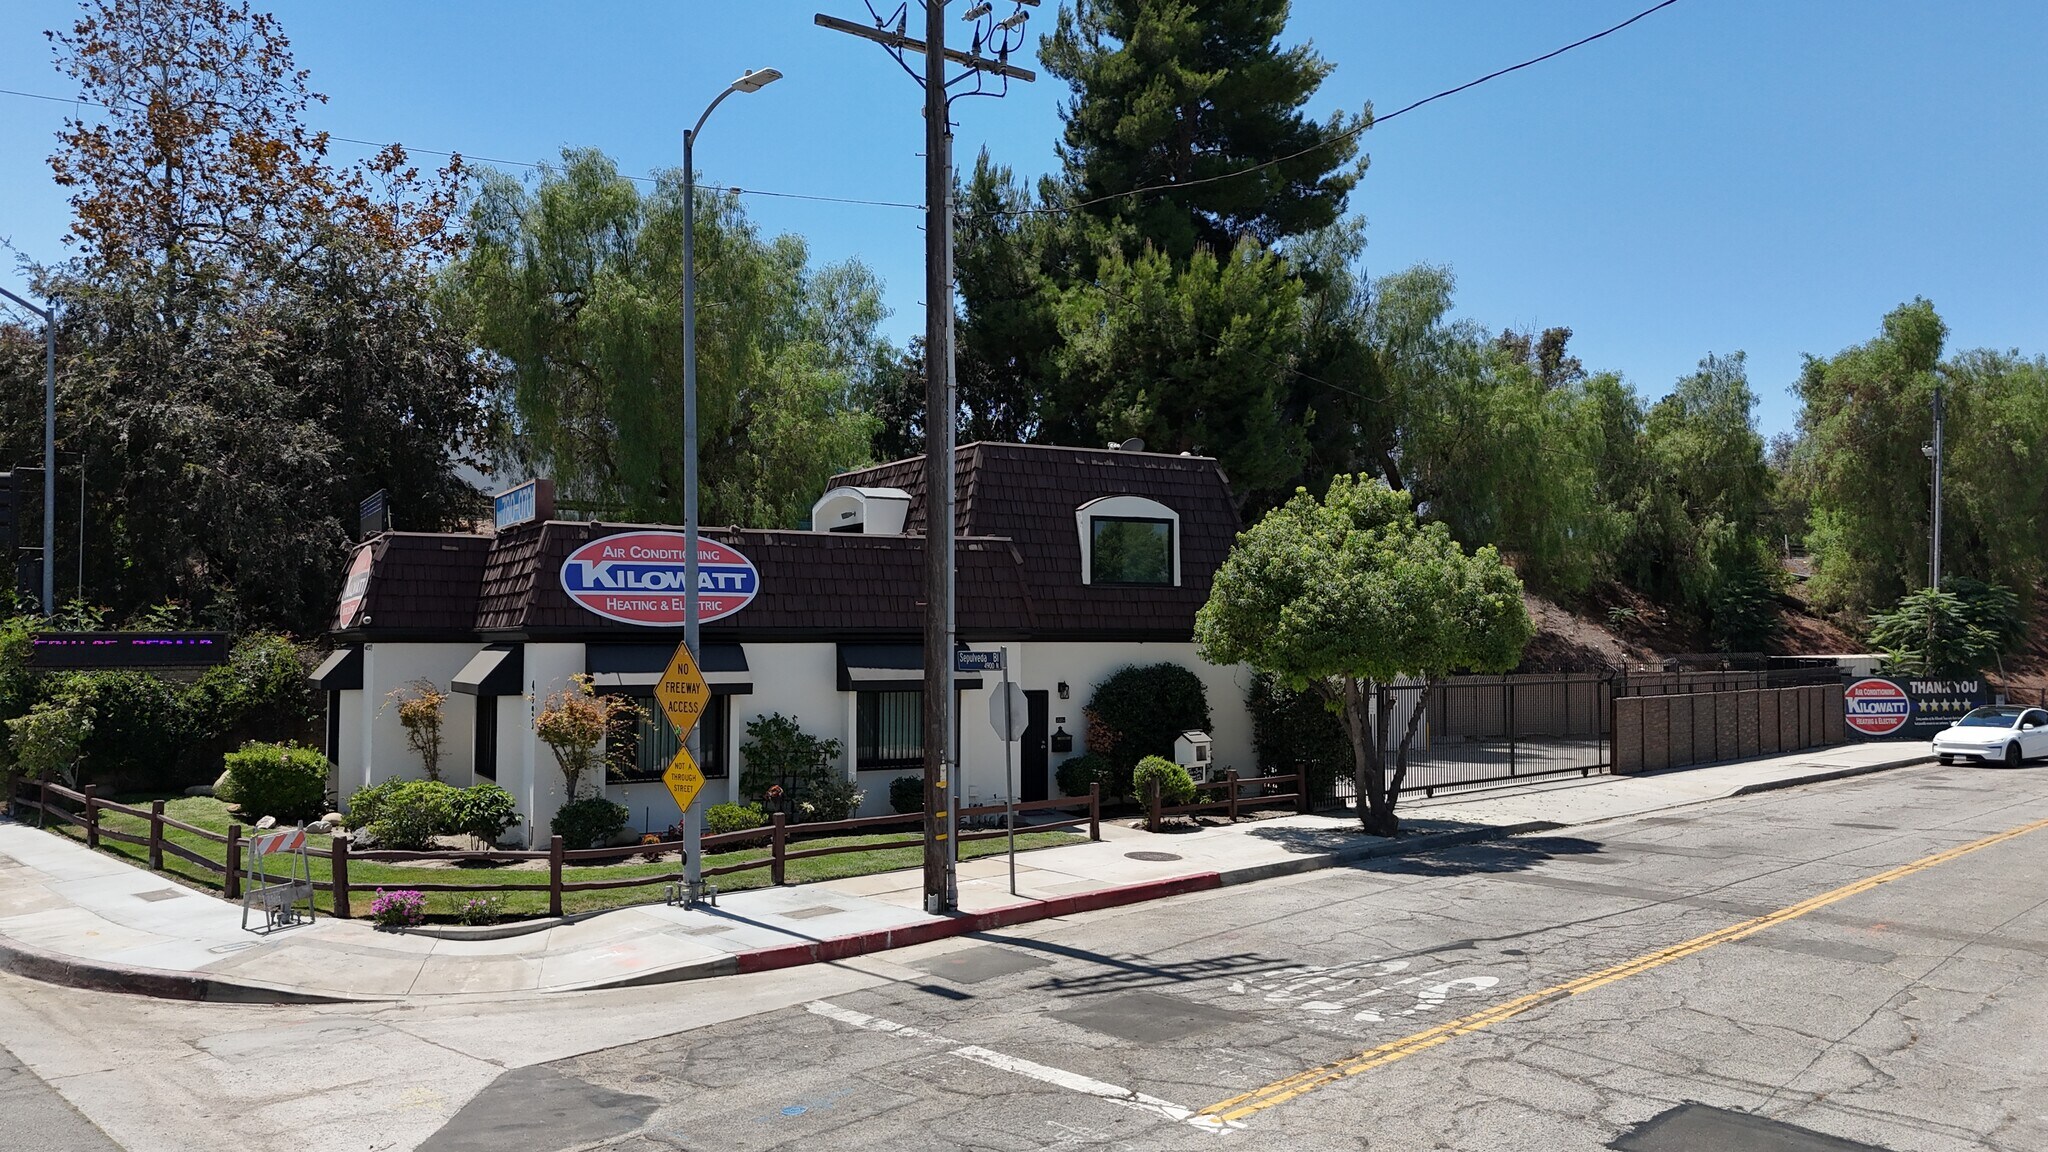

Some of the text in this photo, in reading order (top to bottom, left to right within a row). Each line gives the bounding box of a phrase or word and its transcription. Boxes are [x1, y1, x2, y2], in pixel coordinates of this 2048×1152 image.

[602, 545, 720, 561] AIR CONDITIING
[581, 560, 747, 590] KILOWATT
[606, 598, 722, 611] HEATING & ELTRIC
[960, 653, 987, 664] Sepulveda
[677, 663, 689, 675] NO
[665, 682, 701, 694] FREEWAY
[1855, 688, 1896, 696] AIR CONDITIONING
[1909, 680, 1978, 693] THANK YOU
[668, 701, 699, 713] ACCESS
[1845, 696, 1905, 713] KILOWATT
[1856, 717, 1874, 725] HEATING
[1878, 717, 1898, 725] ELECTRIC
[674, 762, 692, 771] NOT A
[671, 773, 697, 782] THROUGH
[673, 784, 693, 793] STREET
